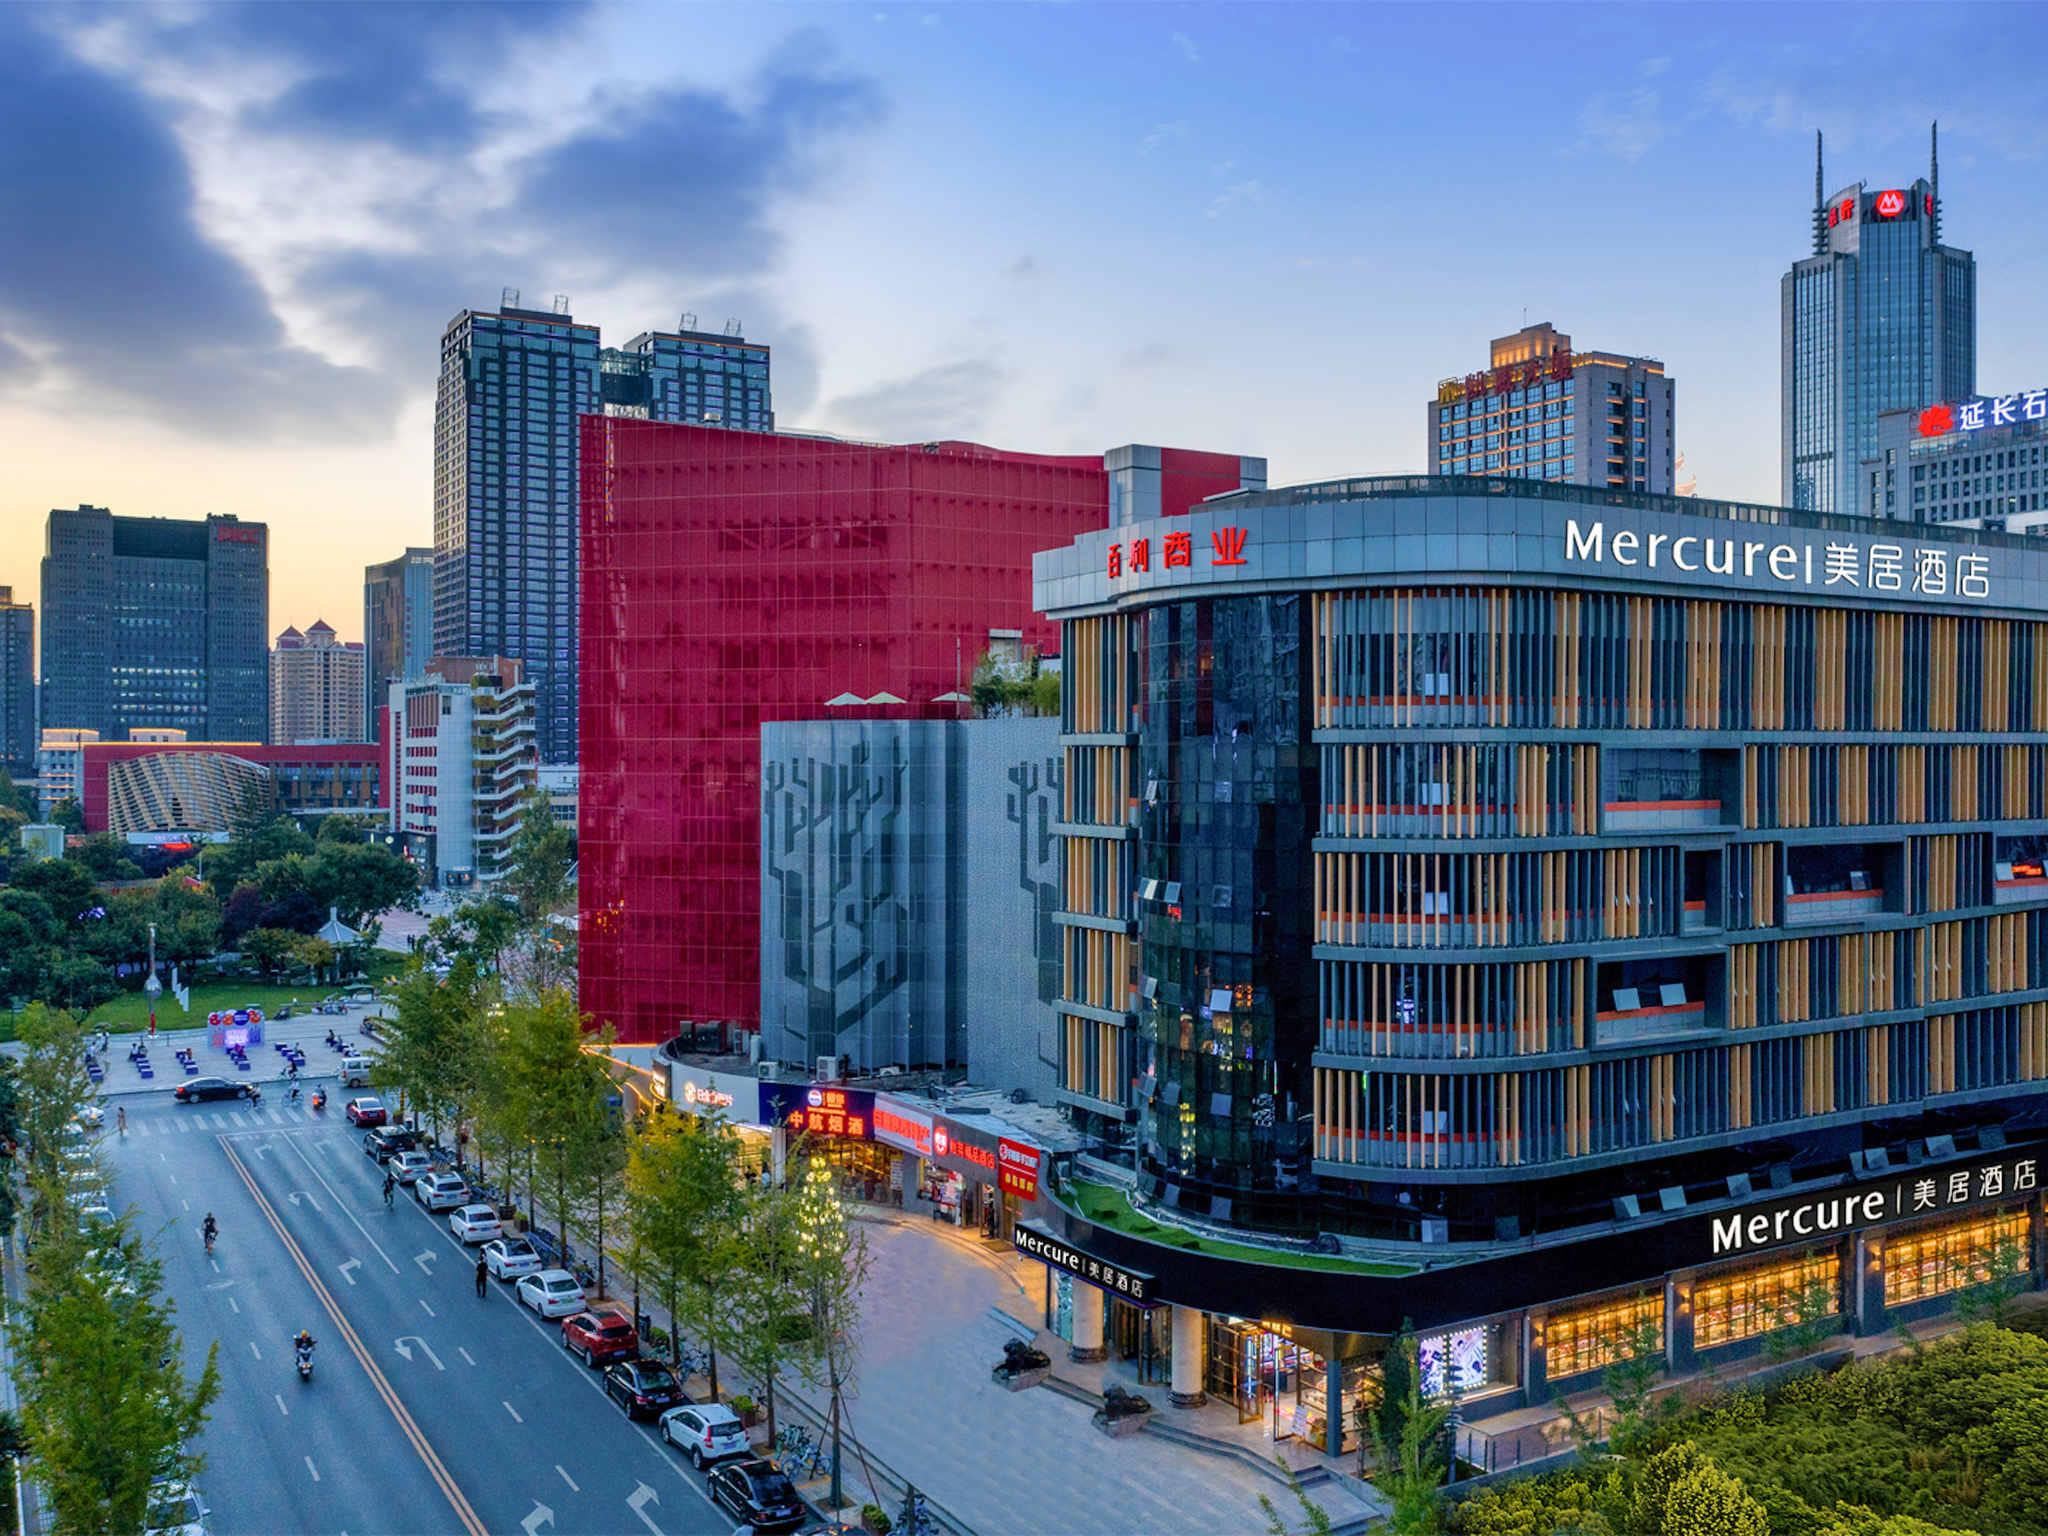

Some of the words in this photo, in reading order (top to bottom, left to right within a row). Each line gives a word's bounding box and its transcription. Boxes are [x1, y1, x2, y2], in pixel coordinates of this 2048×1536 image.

[1107, 527, 1248, 579] 百利商业
[1564, 519, 1798, 581] Mercure
[1824, 540, 1991, 599] 美居酒店
[1711, 1191, 1885, 1254] Mercure
[1912, 1159, 2038, 1212] 美居酒店
[1015, 1229, 1080, 1270] Mercure
[1088, 1261, 1145, 1299] 美居酒店
